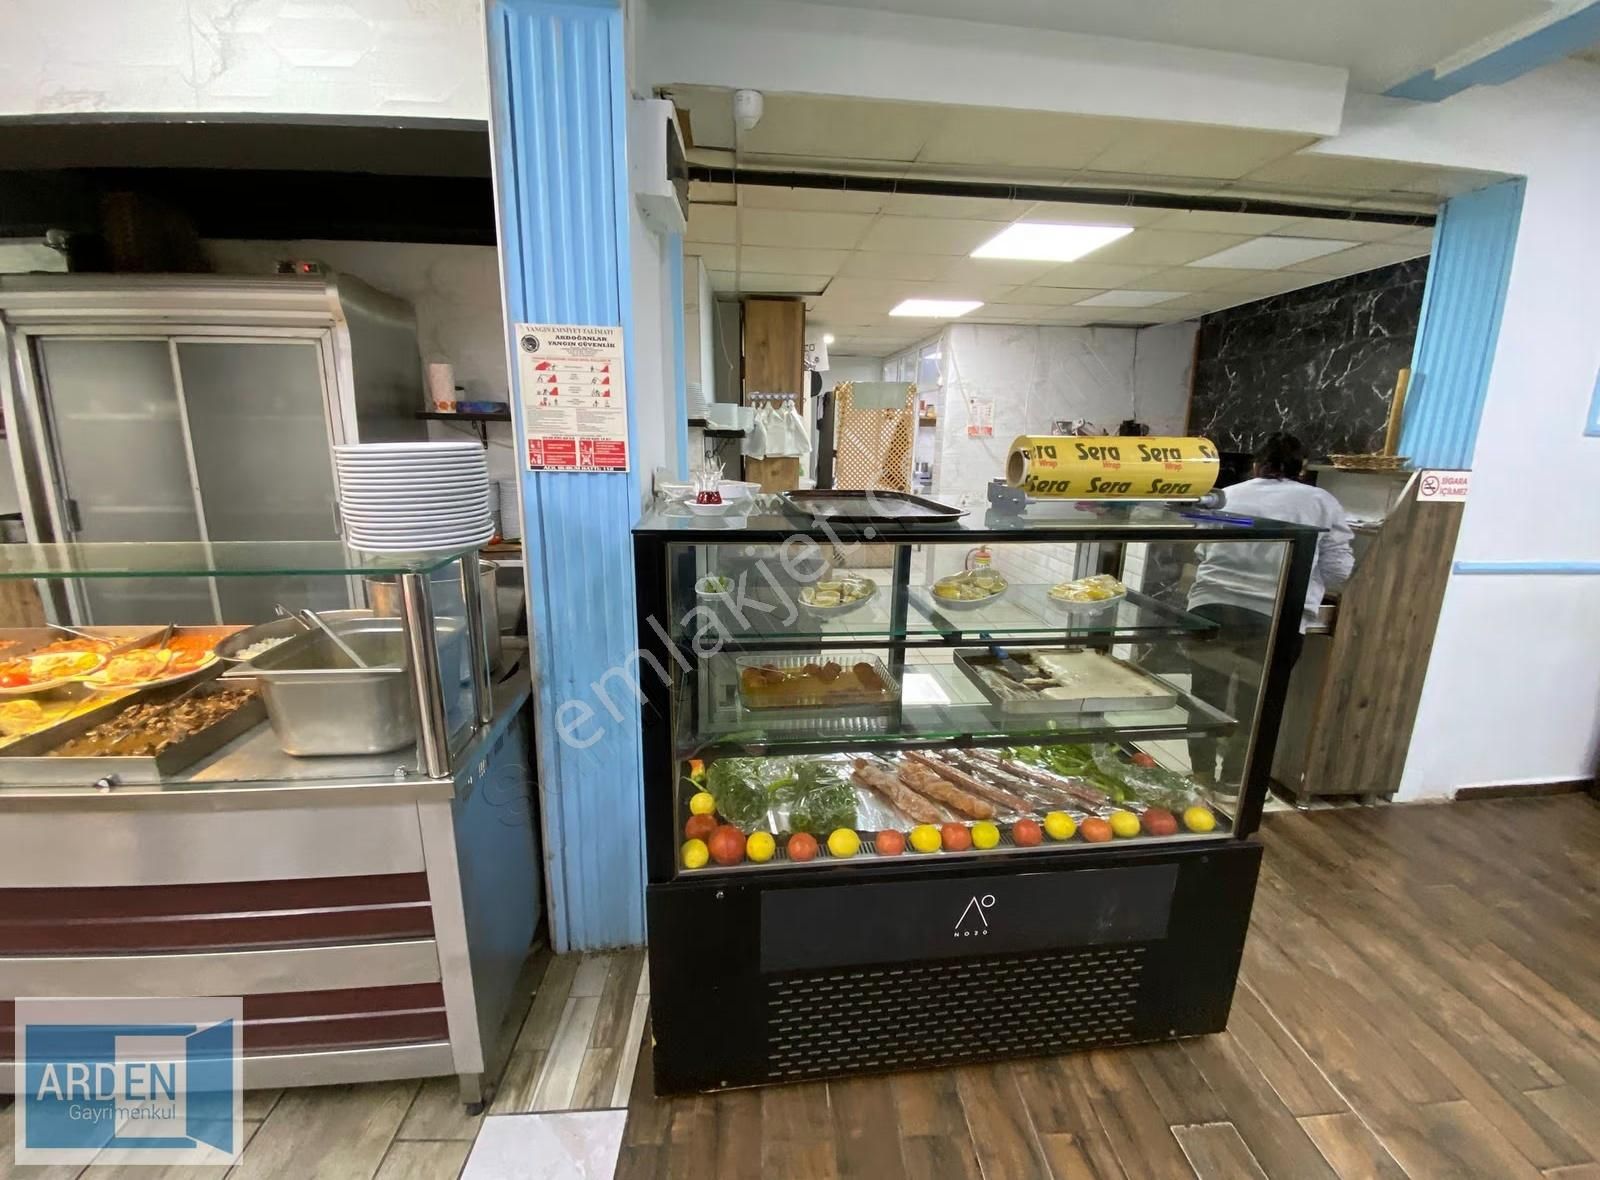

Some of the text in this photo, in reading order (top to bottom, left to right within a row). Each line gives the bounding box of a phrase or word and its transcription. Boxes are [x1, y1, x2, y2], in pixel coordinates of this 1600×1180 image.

[1074, 442, 1121, 461] Sera
[1137, 443, 1181, 464] Sera
[1102, 459, 1121, 471] Wrap
[1164, 461, 1183, 473] Wrap
[1085, 476, 1133, 495] Sera
[1146, 478, 1193, 495] Sera
[1441, 476, 1468, 485] SİGARA
